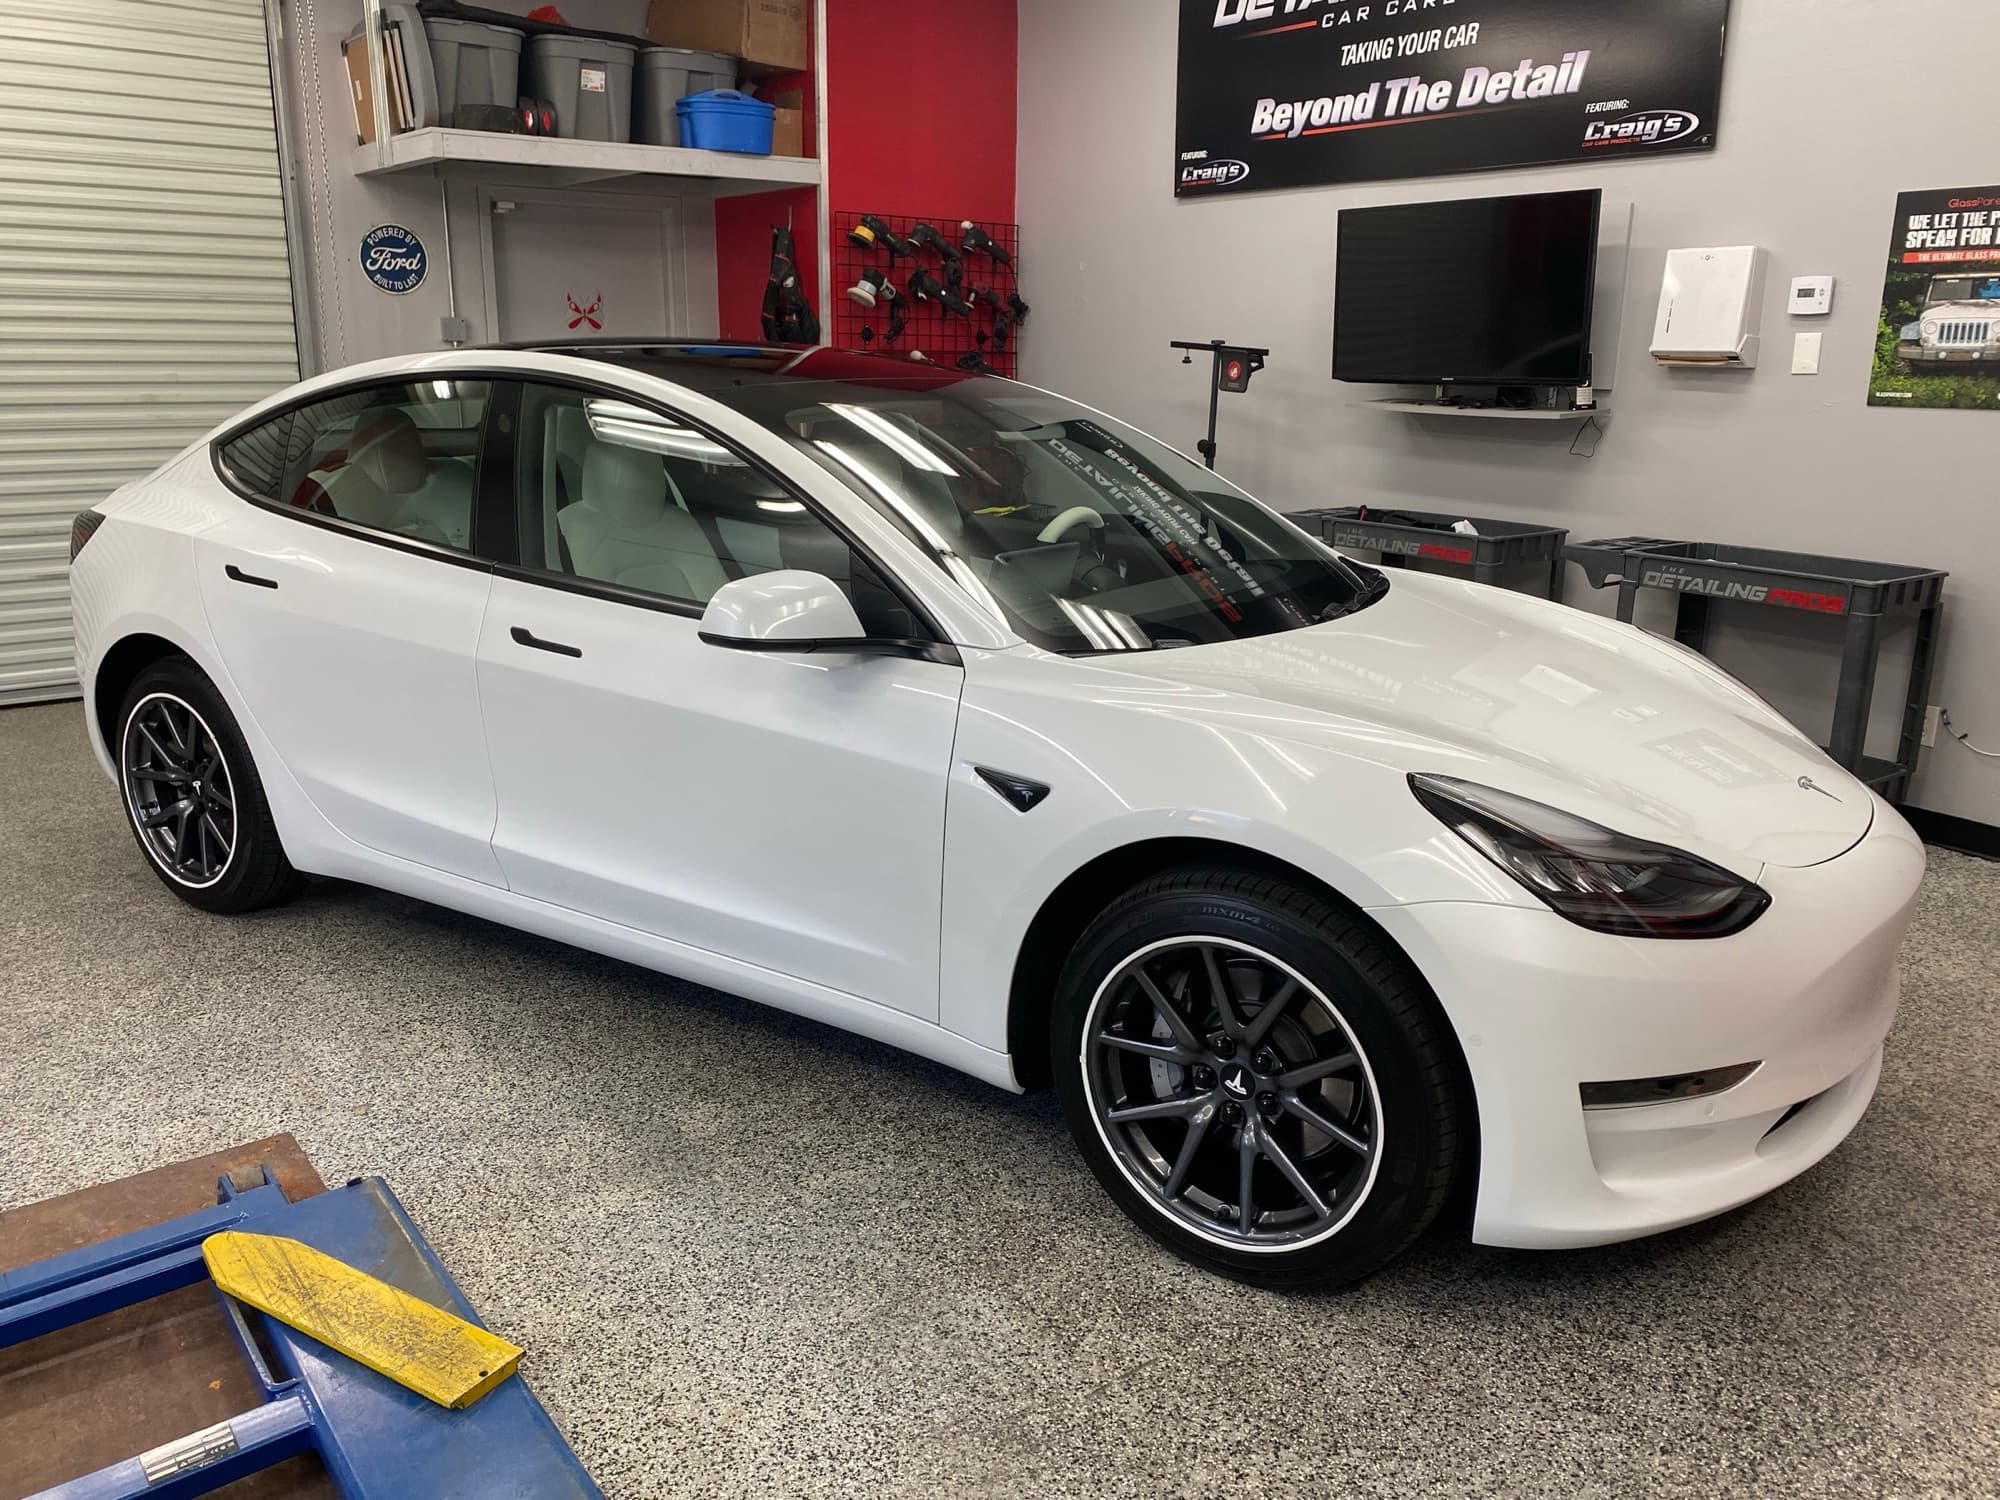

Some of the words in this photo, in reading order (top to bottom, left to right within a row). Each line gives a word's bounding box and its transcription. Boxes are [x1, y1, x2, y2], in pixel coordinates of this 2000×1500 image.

[1321, 6, 1370, 28] CAR
[1385, 0, 1457, 16] CAR
[1341, 37, 1393, 66] TAKING
[1397, 28, 1442, 57] YOUR
[1444, 22, 1480, 49] CAR
[1250, 82, 1381, 139] Beyond
[1384, 75, 1452, 117] The
[1456, 50, 1592, 108] Detail
[1585, 99, 1629, 114] FEATURING:
[1584, 113, 1683, 141] Craig's
[1181, 163, 1240, 183] Craig's
[1908, 214, 1932, 230] WE
[1934, 212, 1960, 228] LET
[1962, 211, 1988, 227] THE
[367, 227, 405, 246] POWERED
[405, 234, 417, 246] BY
[1905, 229, 1958, 248] SPEAK
[1960, 227, 1993, 247] FOR
[366, 246, 421, 271] Ford
[1966, 250, 1988, 260] GLASS
[373, 273, 393, 289] BUILT
[394, 281, 404, 290] TO
[404, 273, 419, 289] LAST
[1335, 533, 1421, 556] DETAILING
[1418, 543, 1473, 564] PROS
[1661, 565, 1685, 573] THE
[1642, 570, 1769, 601] DETAILING
[1767, 588, 1847, 614] PROS
